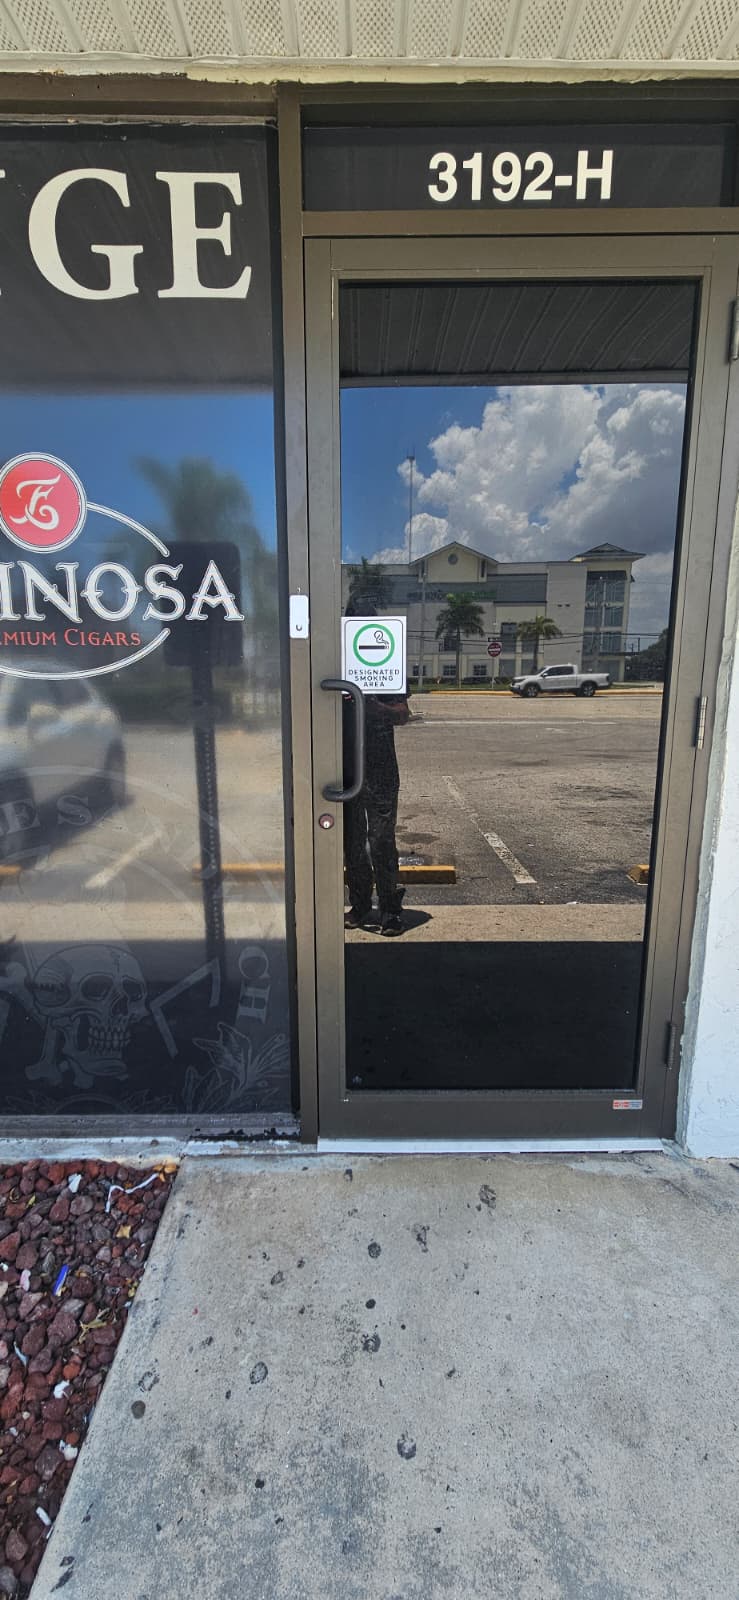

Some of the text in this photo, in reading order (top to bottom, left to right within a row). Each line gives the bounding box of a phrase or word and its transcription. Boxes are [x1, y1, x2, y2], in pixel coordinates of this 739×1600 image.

[427, 150, 614, 202] 3192-H
[0, 168, 252, 301] GE
[0, 628, 142, 646] MIUM CIGARS
